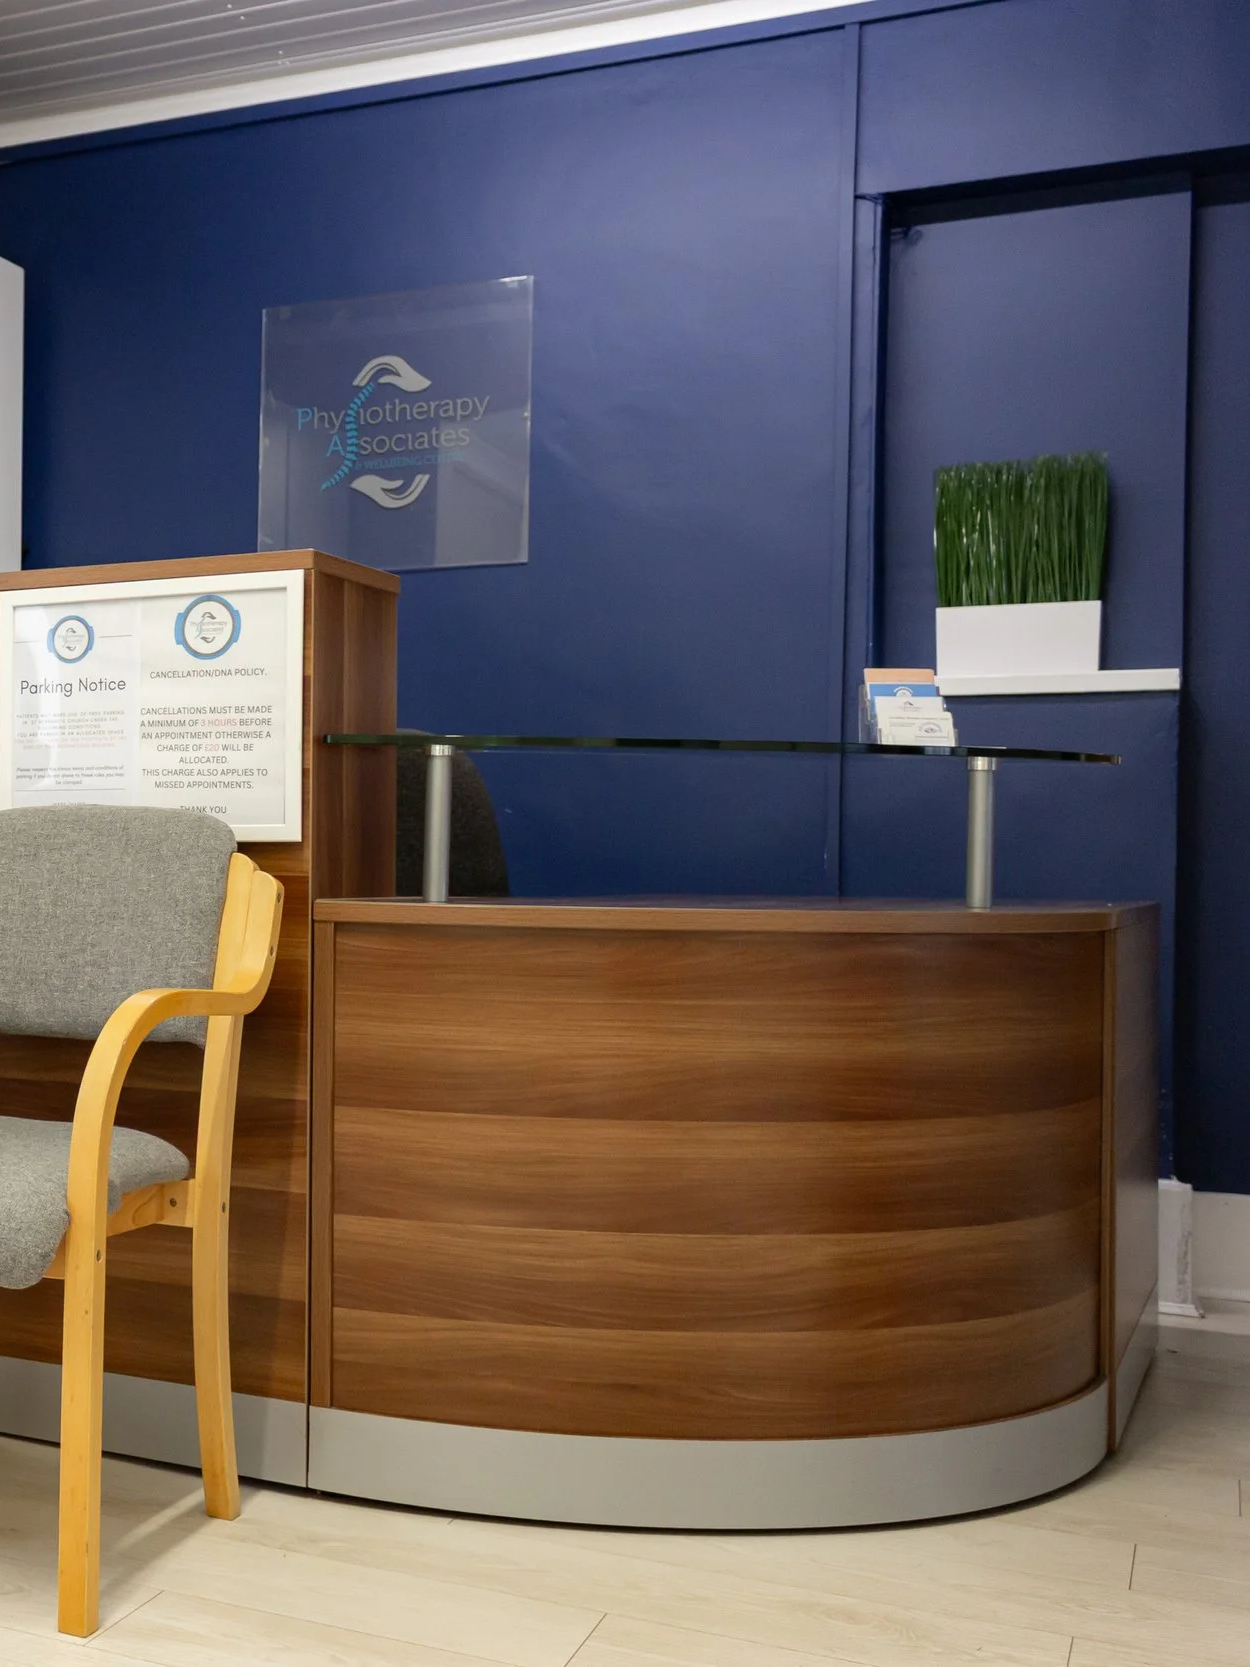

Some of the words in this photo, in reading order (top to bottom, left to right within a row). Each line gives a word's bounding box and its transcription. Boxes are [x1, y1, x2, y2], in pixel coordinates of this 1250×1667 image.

[150, 669, 233, 679] CANCELLATION/DNA
[234, 667, 268, 677] POLICY.
[20, 678, 73, 697] Parking
[78, 677, 127, 692] Notice
[140, 706, 207, 715] CANCELLATIONS
[209, 705, 232, 714] MUST
[247, 705, 272, 713] MADE
[147, 719, 186, 727] MINIMUM
[188, 719, 199, 727] OF
[208, 718, 237, 727] HOURS
[239, 718, 272, 726] BEFORE
[141, 732, 153, 740] AN
[154, 731, 212, 739] APPOINTMENT
[215, 730, 263, 739] OTHERWISE
[265, 730, 272, 738] A
[157, 744, 190, 752] CHARGE
[204, 744, 219, 752] £20
[221, 743, 241, 751] WILL
[243, 743, 254, 751] BE
[179, 756, 229, 764] ALLOCATED.
[142, 768, 160, 776] THIS
[161, 768, 194, 776] CHARGE
[196, 768, 218, 776] ALSO
[220, 768, 255, 776] APPLIES
[256, 768, 268, 776] TO
[154, 780, 185, 789] MISSED
[186, 780, 254, 789] APPOINTMENTS.
[209, 805, 227, 814] YOU
